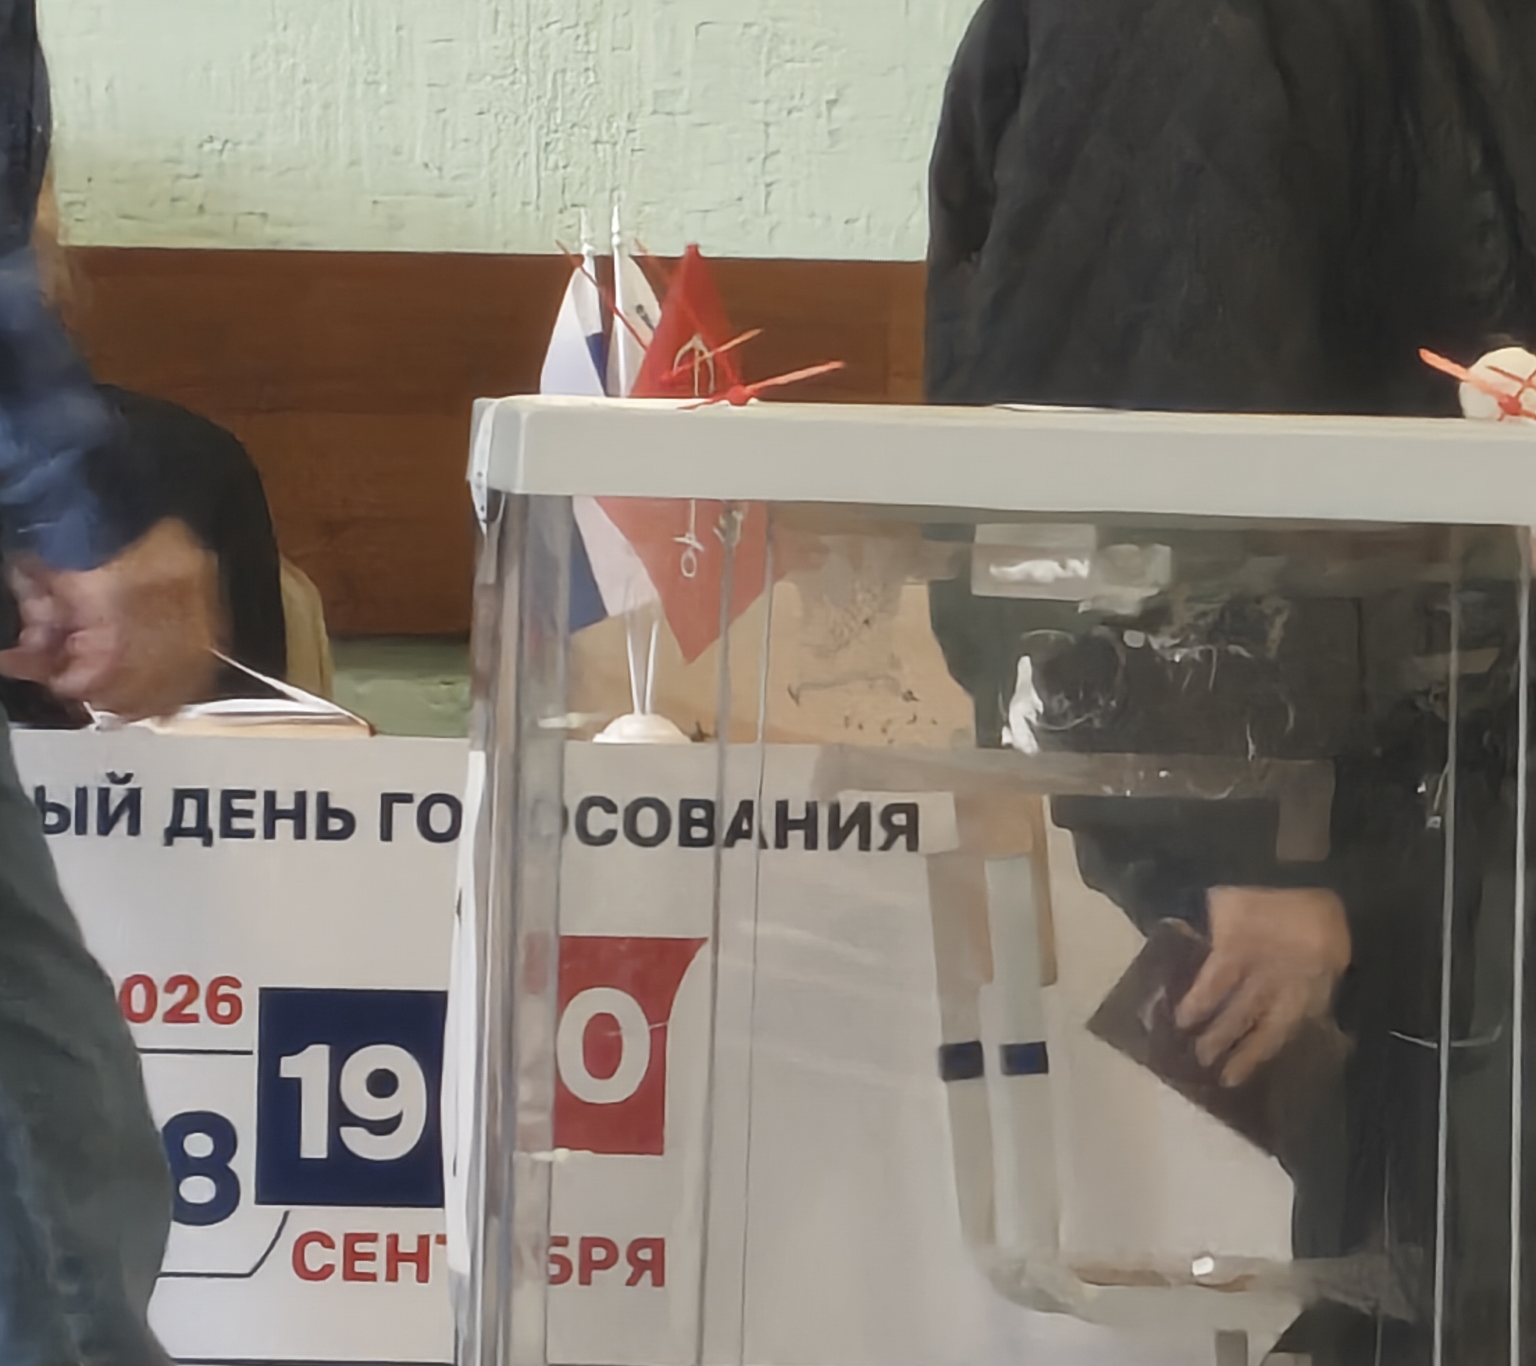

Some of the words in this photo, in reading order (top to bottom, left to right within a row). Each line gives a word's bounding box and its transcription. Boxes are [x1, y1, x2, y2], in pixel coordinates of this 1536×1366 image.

[34, 771, 142, 837] ЫЙ
[163, 787, 357, 847] ДЕНЬ
[379, 792, 920, 853] ГОСОВАНИЯ
[119, 974, 243, 1025] 026
[161, 1110, 241, 1227] 8
[279, 1043, 427, 1161] 19
[556, 986, 652, 1104] 0
[291, 1230, 666, 1288] СЕНБРЯ
